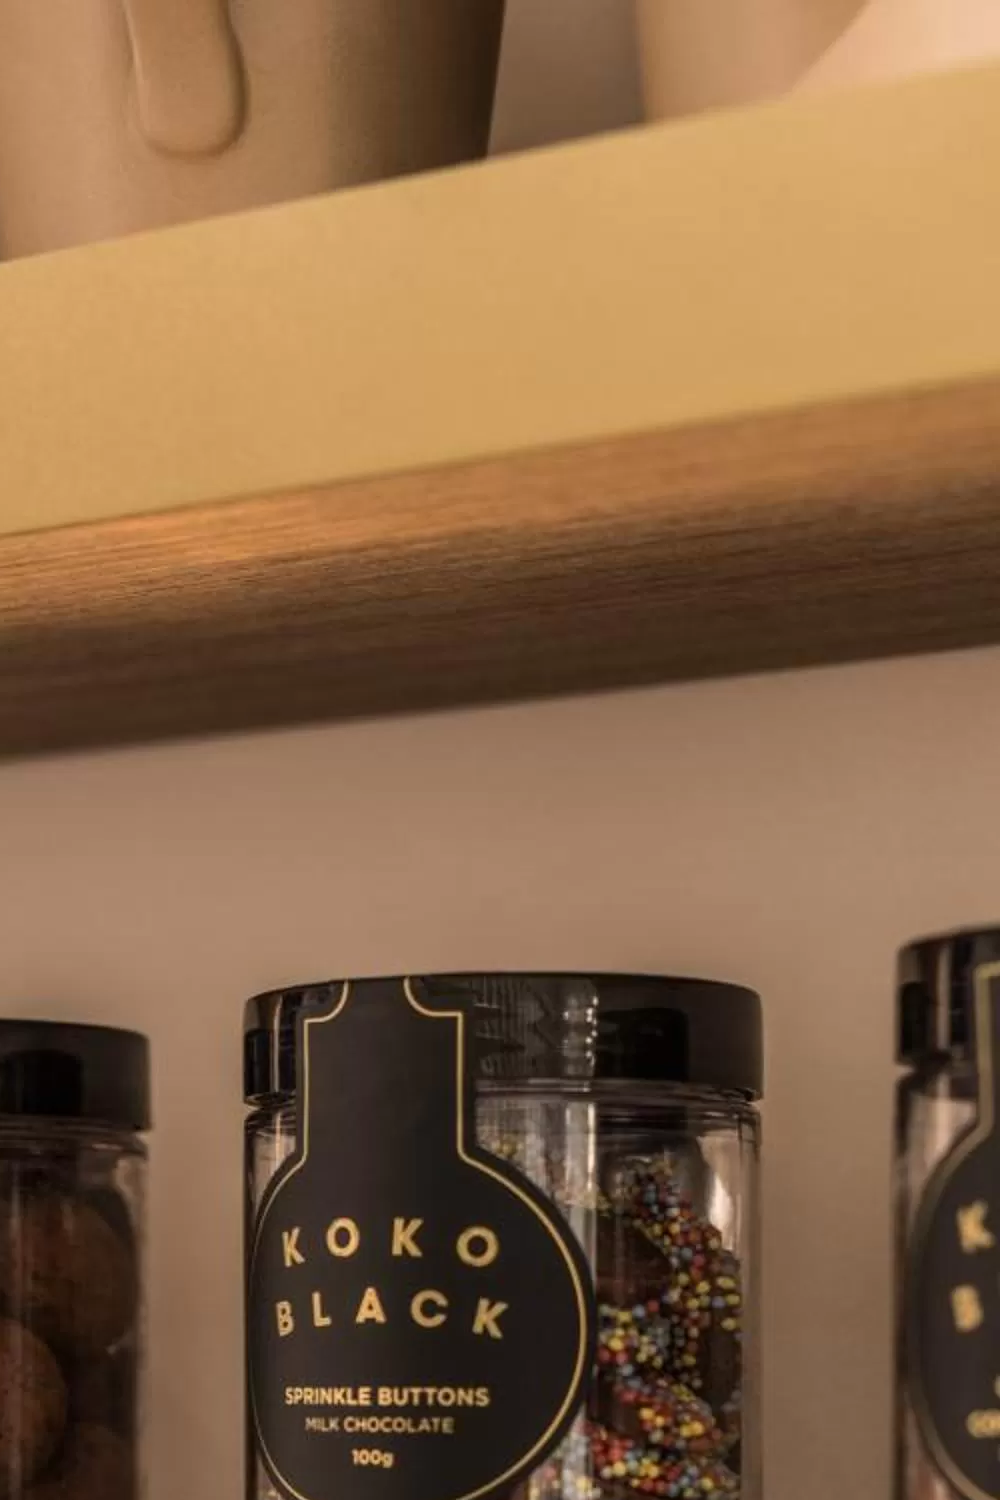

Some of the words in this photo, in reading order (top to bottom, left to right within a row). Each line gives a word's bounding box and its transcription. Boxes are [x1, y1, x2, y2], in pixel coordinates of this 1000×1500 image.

[282, 1217, 499, 1268] KOKO
[275, 1286, 508, 1339] BLACK
[285, 1386, 372, 1406] SPRINKLE
[377, 1386, 490, 1407] BUTTONS
[305, 1416, 340, 1433] MILK
[343, 1416, 454, 1434] CHOCOLATE
[351, 1449, 394, 1468] 100g
